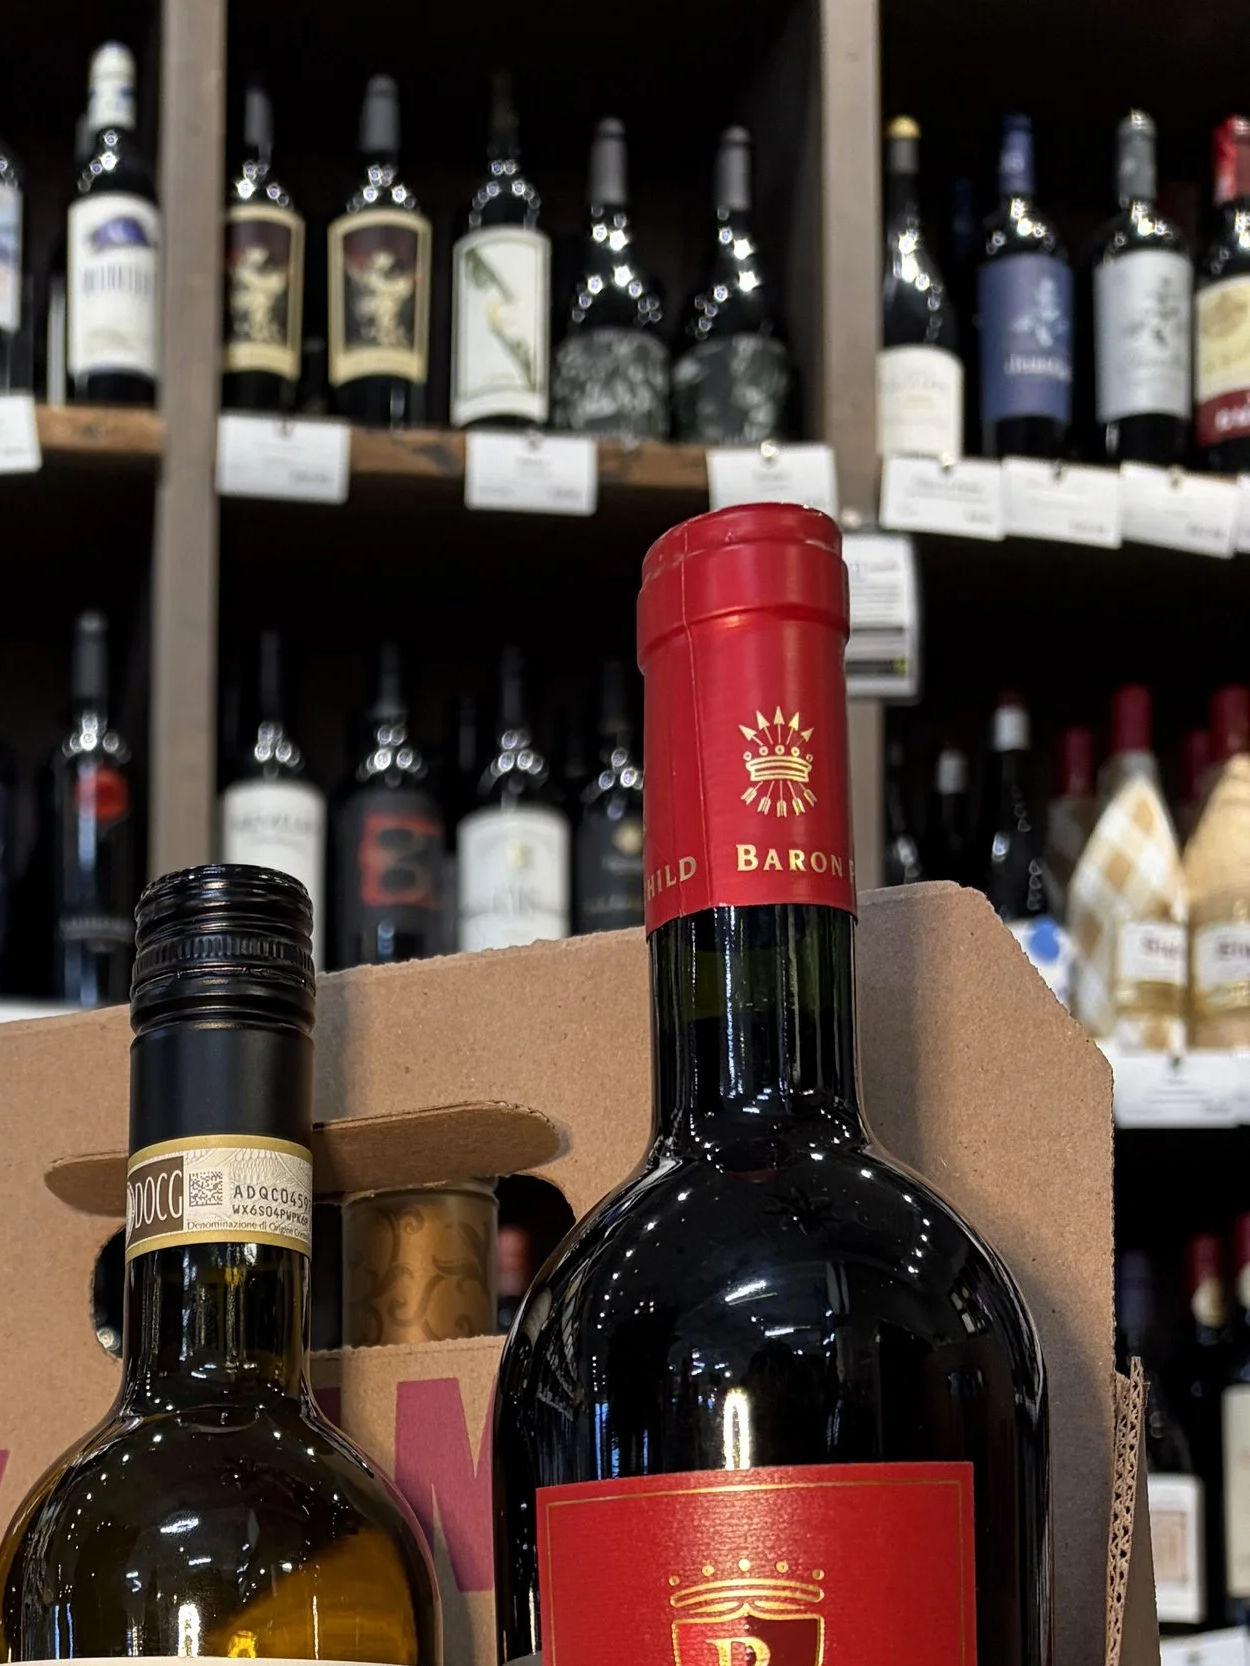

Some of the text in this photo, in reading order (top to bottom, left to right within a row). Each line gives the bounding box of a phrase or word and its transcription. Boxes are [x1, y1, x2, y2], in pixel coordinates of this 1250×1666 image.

[736, 844, 843, 878] BARON
[134, 1169, 183, 1229] DOCG
[187, 1220, 257, 1231] Denominazione
[258, 1221, 268, 1231] di
[269, 1222, 294, 1236] Origine
